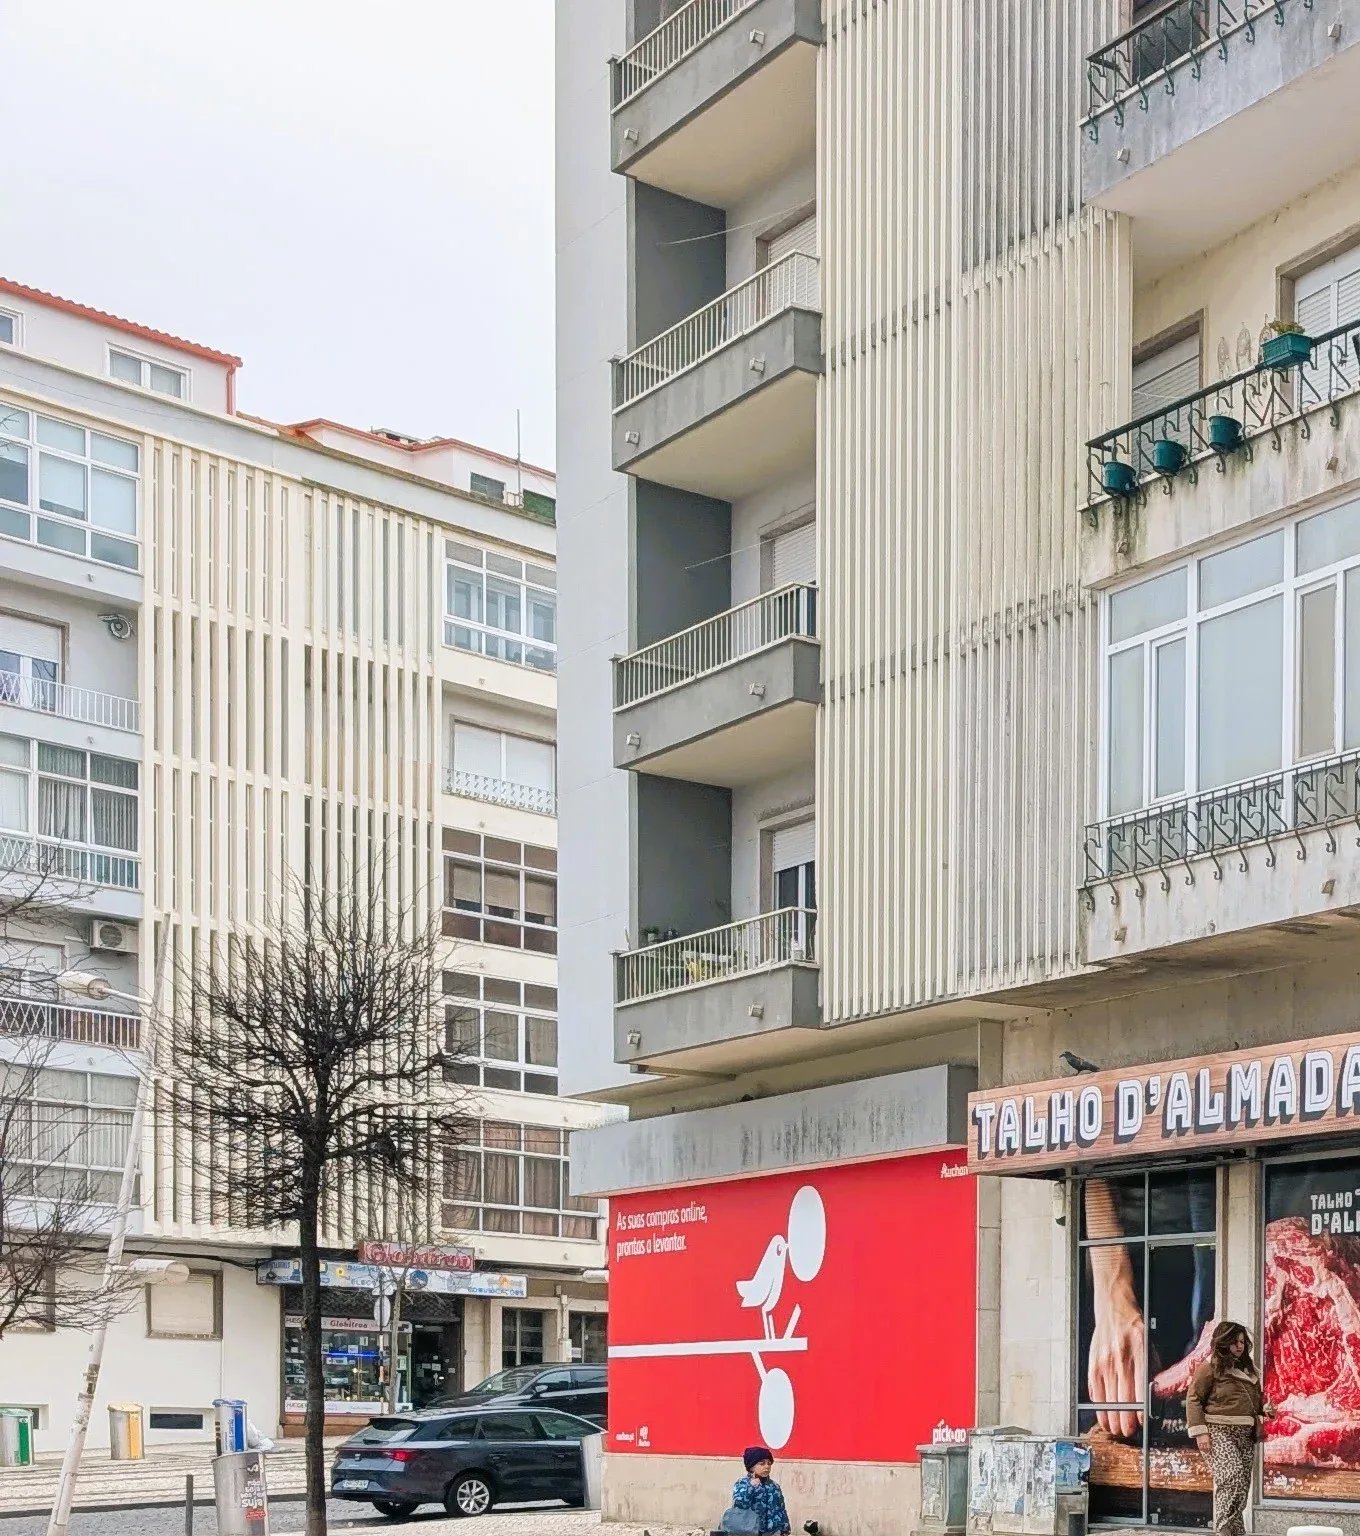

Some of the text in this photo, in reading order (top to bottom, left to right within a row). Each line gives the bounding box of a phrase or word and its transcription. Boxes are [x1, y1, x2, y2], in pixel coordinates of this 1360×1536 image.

[973, 1086, 1103, 1158] TALHO
[941, 1163, 968, 1179] Auchan
[1310, 1191, 1353, 1211] TALHO
[616, 1203, 707, 1231] As suas compras online,
[616, 1239, 645, 1262] prontas
[653, 1233, 687, 1252] levantar.
